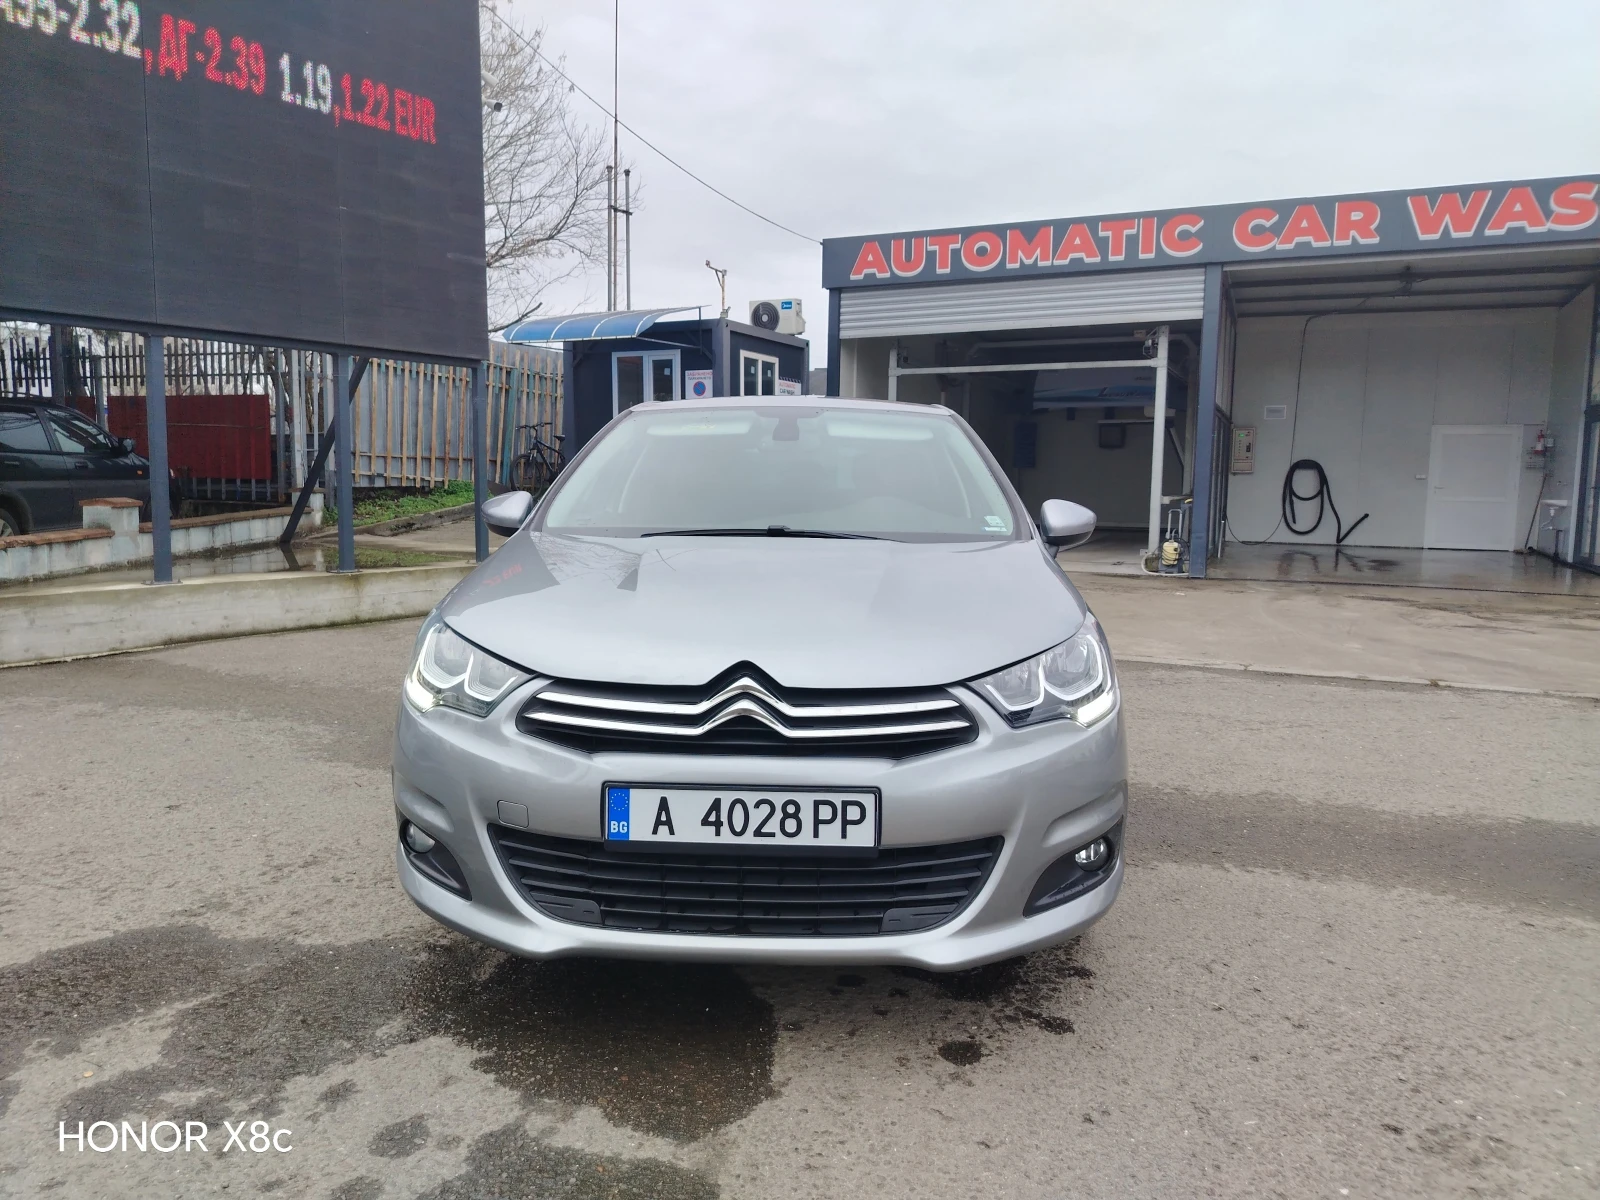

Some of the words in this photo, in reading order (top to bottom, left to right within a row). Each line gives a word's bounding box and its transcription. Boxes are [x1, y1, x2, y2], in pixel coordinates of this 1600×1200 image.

[394, 87, 437, 145] EUR
[849, 213, 1204, 281] AUTOMATIC
[1232, 200, 1381, 253] CAR
[610, 820, 628, 834] BG
[651, 796, 675, 836] A
[700, 797, 803, 839] 4028
[812, 799, 867, 839] PP
